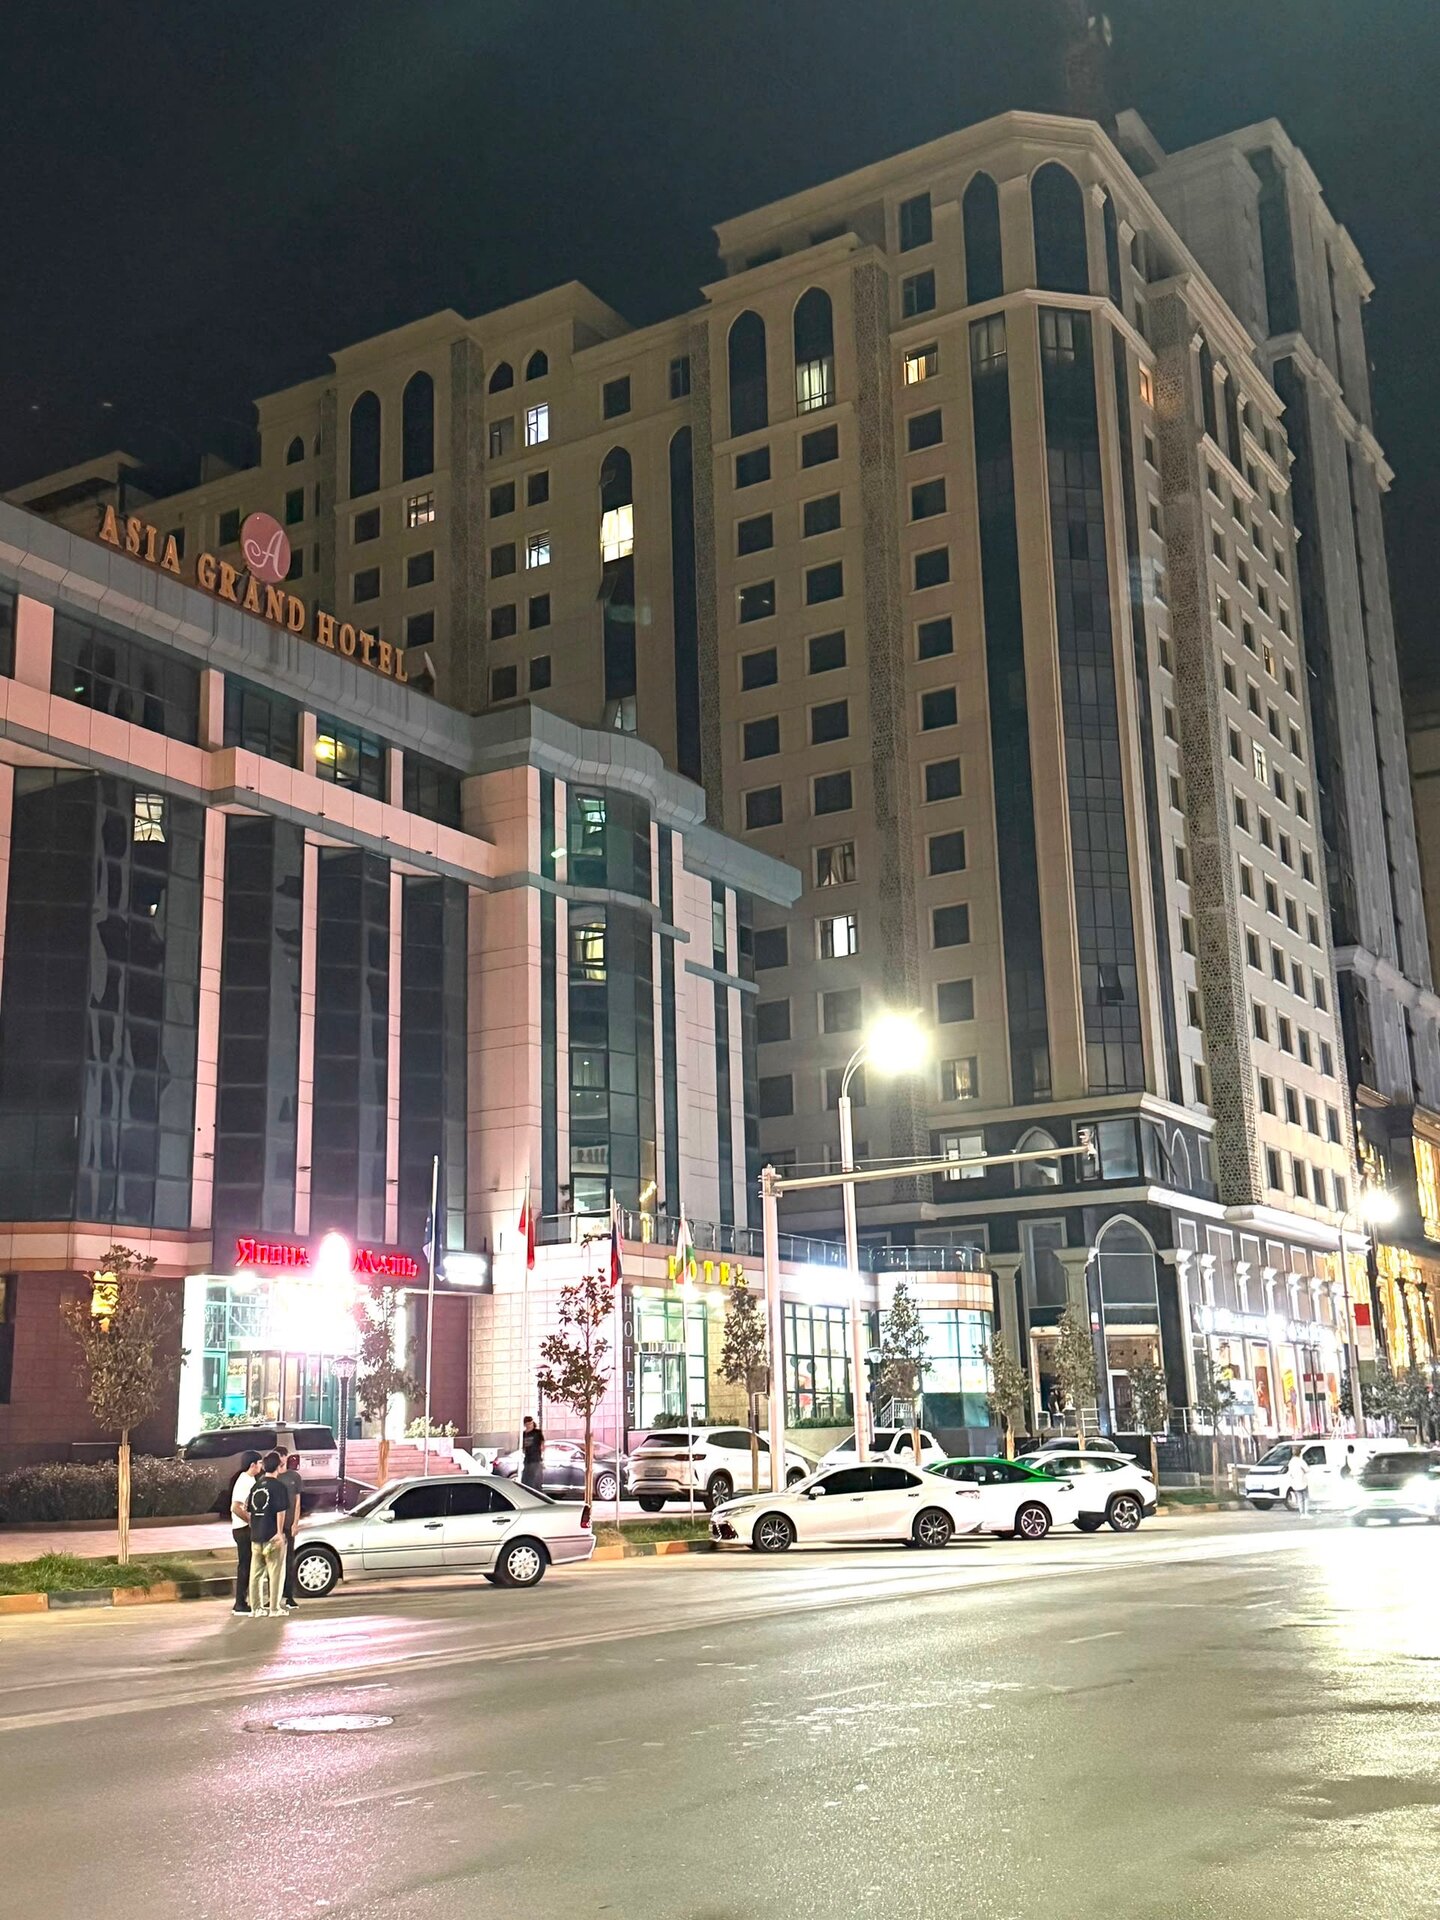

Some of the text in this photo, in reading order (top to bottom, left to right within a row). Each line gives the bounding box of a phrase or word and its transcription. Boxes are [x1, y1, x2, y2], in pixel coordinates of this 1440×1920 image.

[99, 504, 409, 683] ASIA GRAND HOTEL
